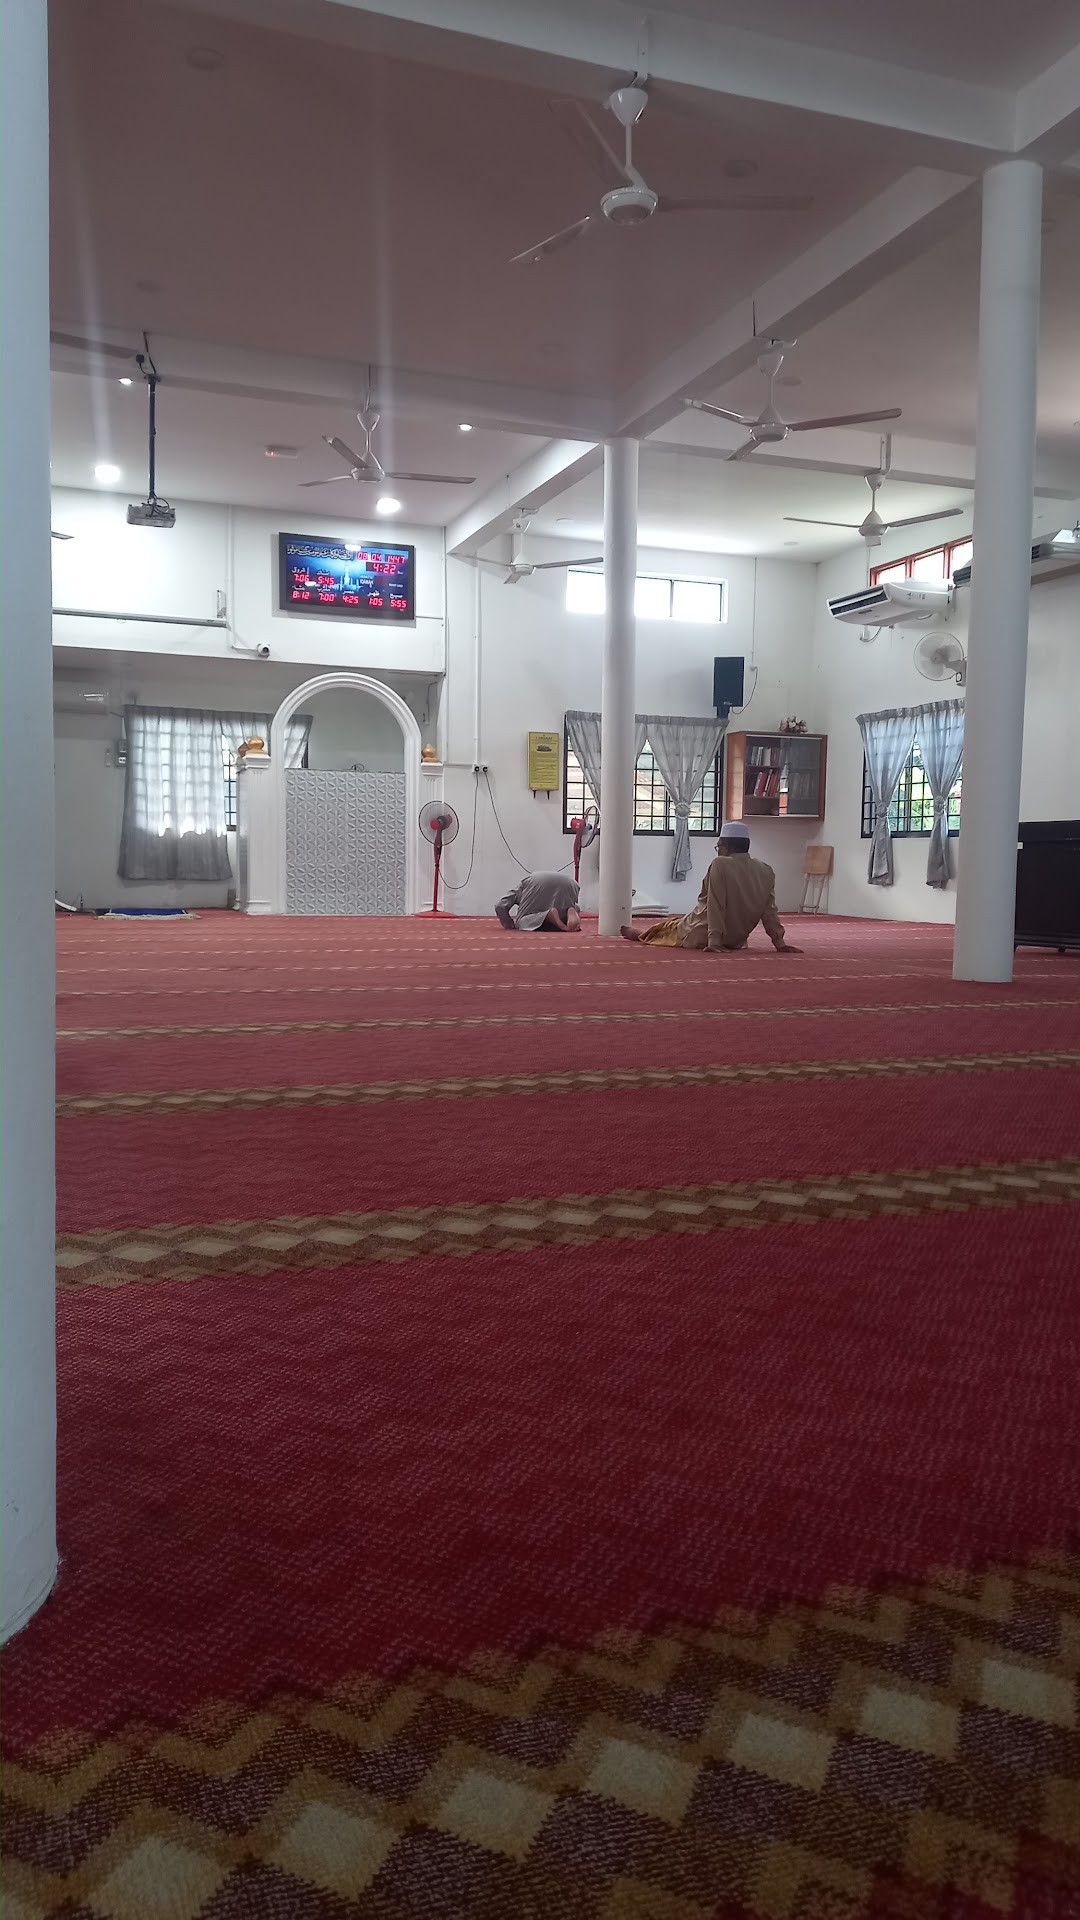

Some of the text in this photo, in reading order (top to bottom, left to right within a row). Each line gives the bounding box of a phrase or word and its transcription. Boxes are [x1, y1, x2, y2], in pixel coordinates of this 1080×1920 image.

[357, 552, 368, 560] 08
[371, 553, 382, 561] 04
[387, 555, 405, 563] 1447
[373, 563, 396, 574] 4:22
[317, 576, 335, 585] 5:45
[292, 590, 310, 599] 8:12
[318, 592, 335, 602] 7:00
[342, 595, 359, 604] 4:25
[369, 597, 384, 606] 1:05
[390, 599, 407, 608] 5:55
